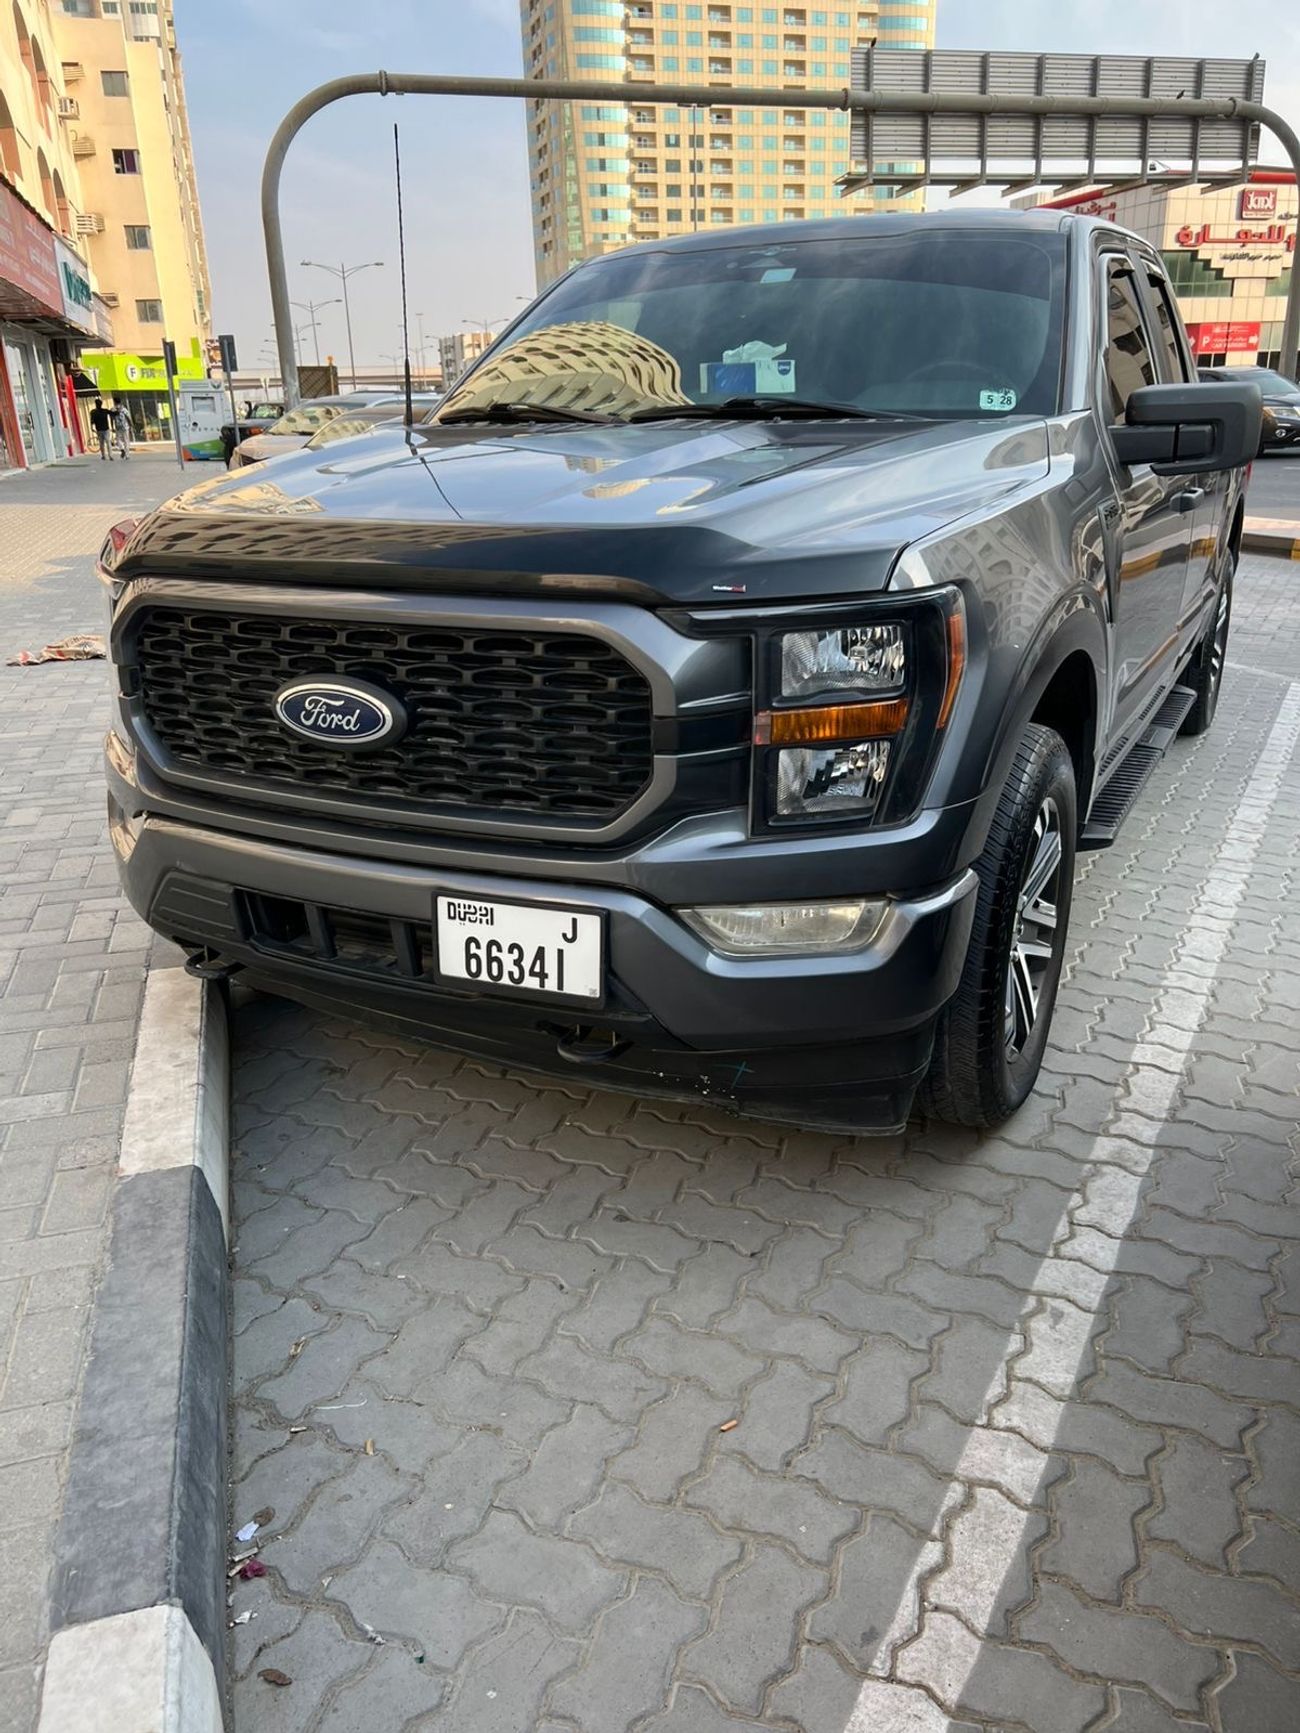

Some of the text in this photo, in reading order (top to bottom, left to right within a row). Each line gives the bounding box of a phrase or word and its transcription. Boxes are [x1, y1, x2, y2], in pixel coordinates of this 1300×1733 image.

[986, 394, 1012, 405] 5 28
[300, 695, 361, 732] Ford
[561, 917, 578, 944] J
[464, 936, 564, 991] 66341
